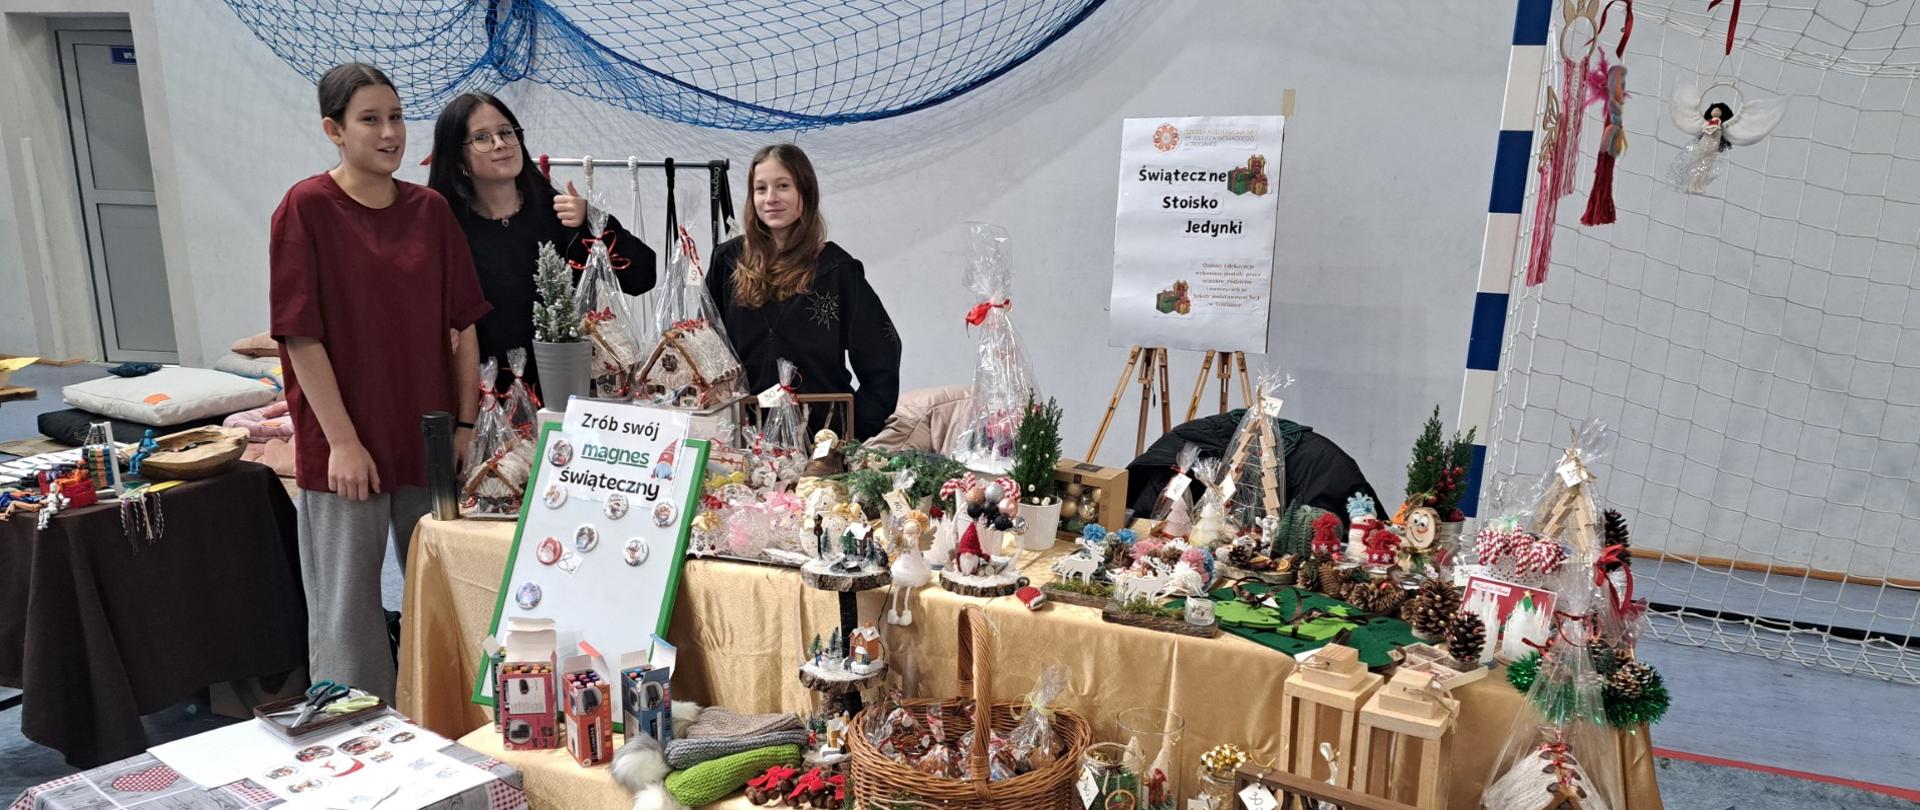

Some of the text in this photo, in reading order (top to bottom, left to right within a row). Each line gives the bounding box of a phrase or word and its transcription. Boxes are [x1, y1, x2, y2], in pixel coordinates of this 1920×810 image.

[1162, 195, 1219, 210] Stoisko
[1184, 219, 1243, 237] Jedynki
[581, 412, 660, 442] Zrób swój
[581, 443, 650, 466] magnes
[558, 466, 660, 502] świąteczny
